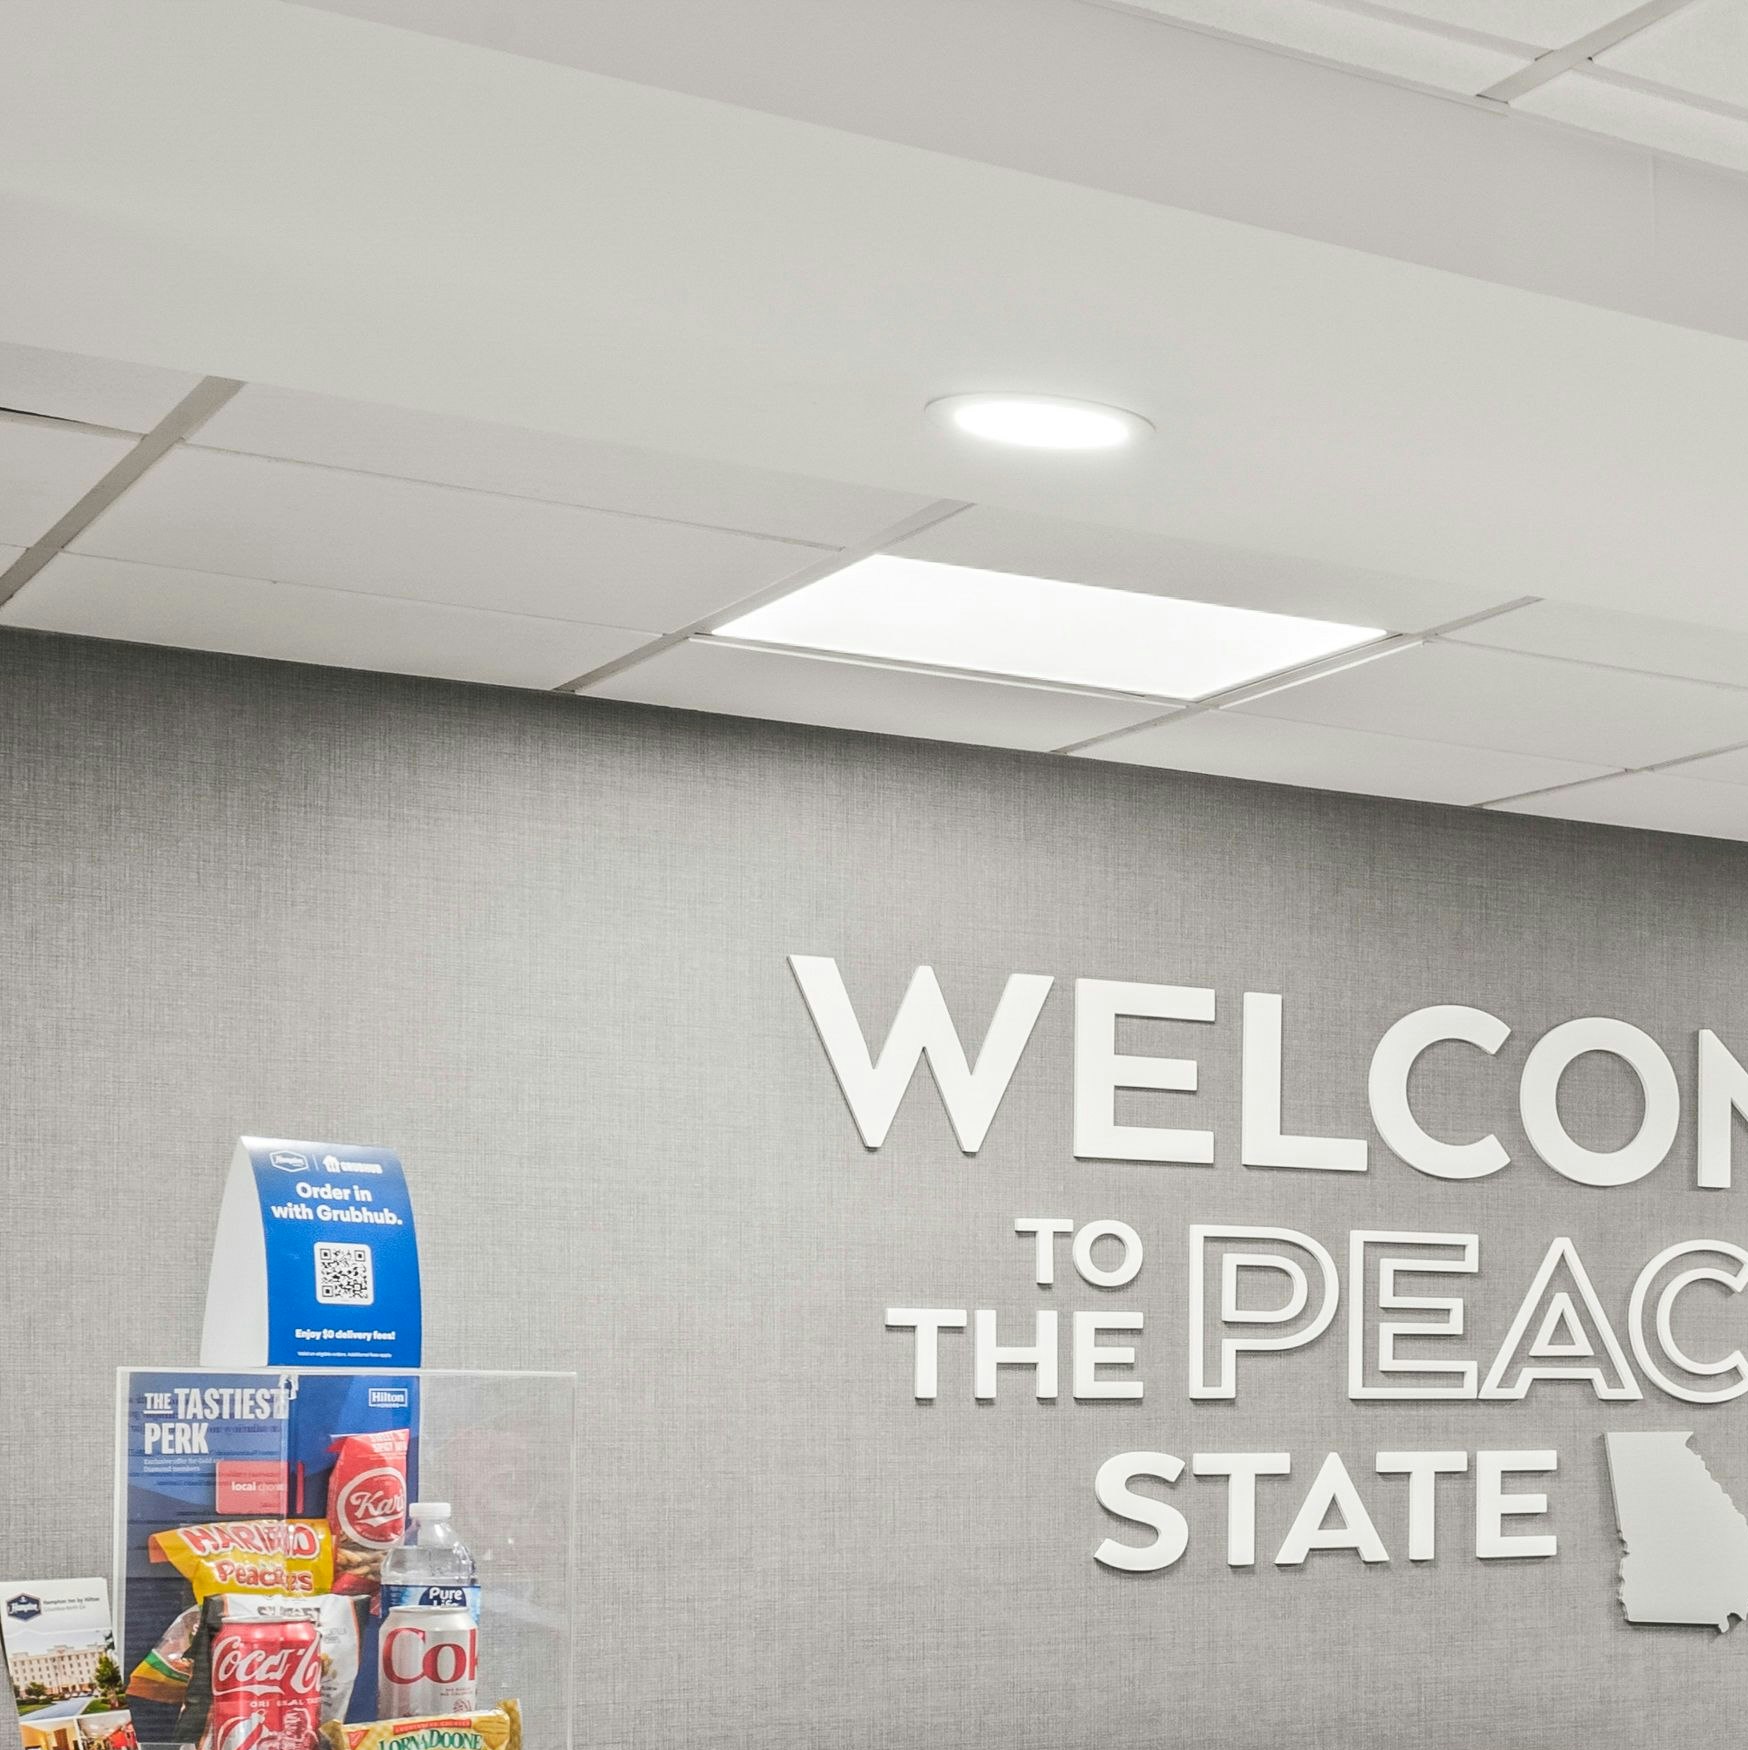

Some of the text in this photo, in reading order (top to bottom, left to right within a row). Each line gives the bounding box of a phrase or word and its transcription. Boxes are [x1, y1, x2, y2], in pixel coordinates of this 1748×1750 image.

[295, 1182, 373, 1203] Order in
[270, 1202, 403, 1226] with Grubhub.
[1014, 1216, 1144, 1288] TO
[885, 1307, 1145, 1400] THE
[143, 1387, 288, 1420] THE TASTIEST
[371, 1391, 405, 1403] Hilton
[144, 1421, 209, 1455] PERK
[231, 1481, 257, 1492] local
[1093, 1448, 1558, 1573] STATE
[429, 1586, 463, 1600] Pure
[429, 1729, 484, 1750] DOONE
